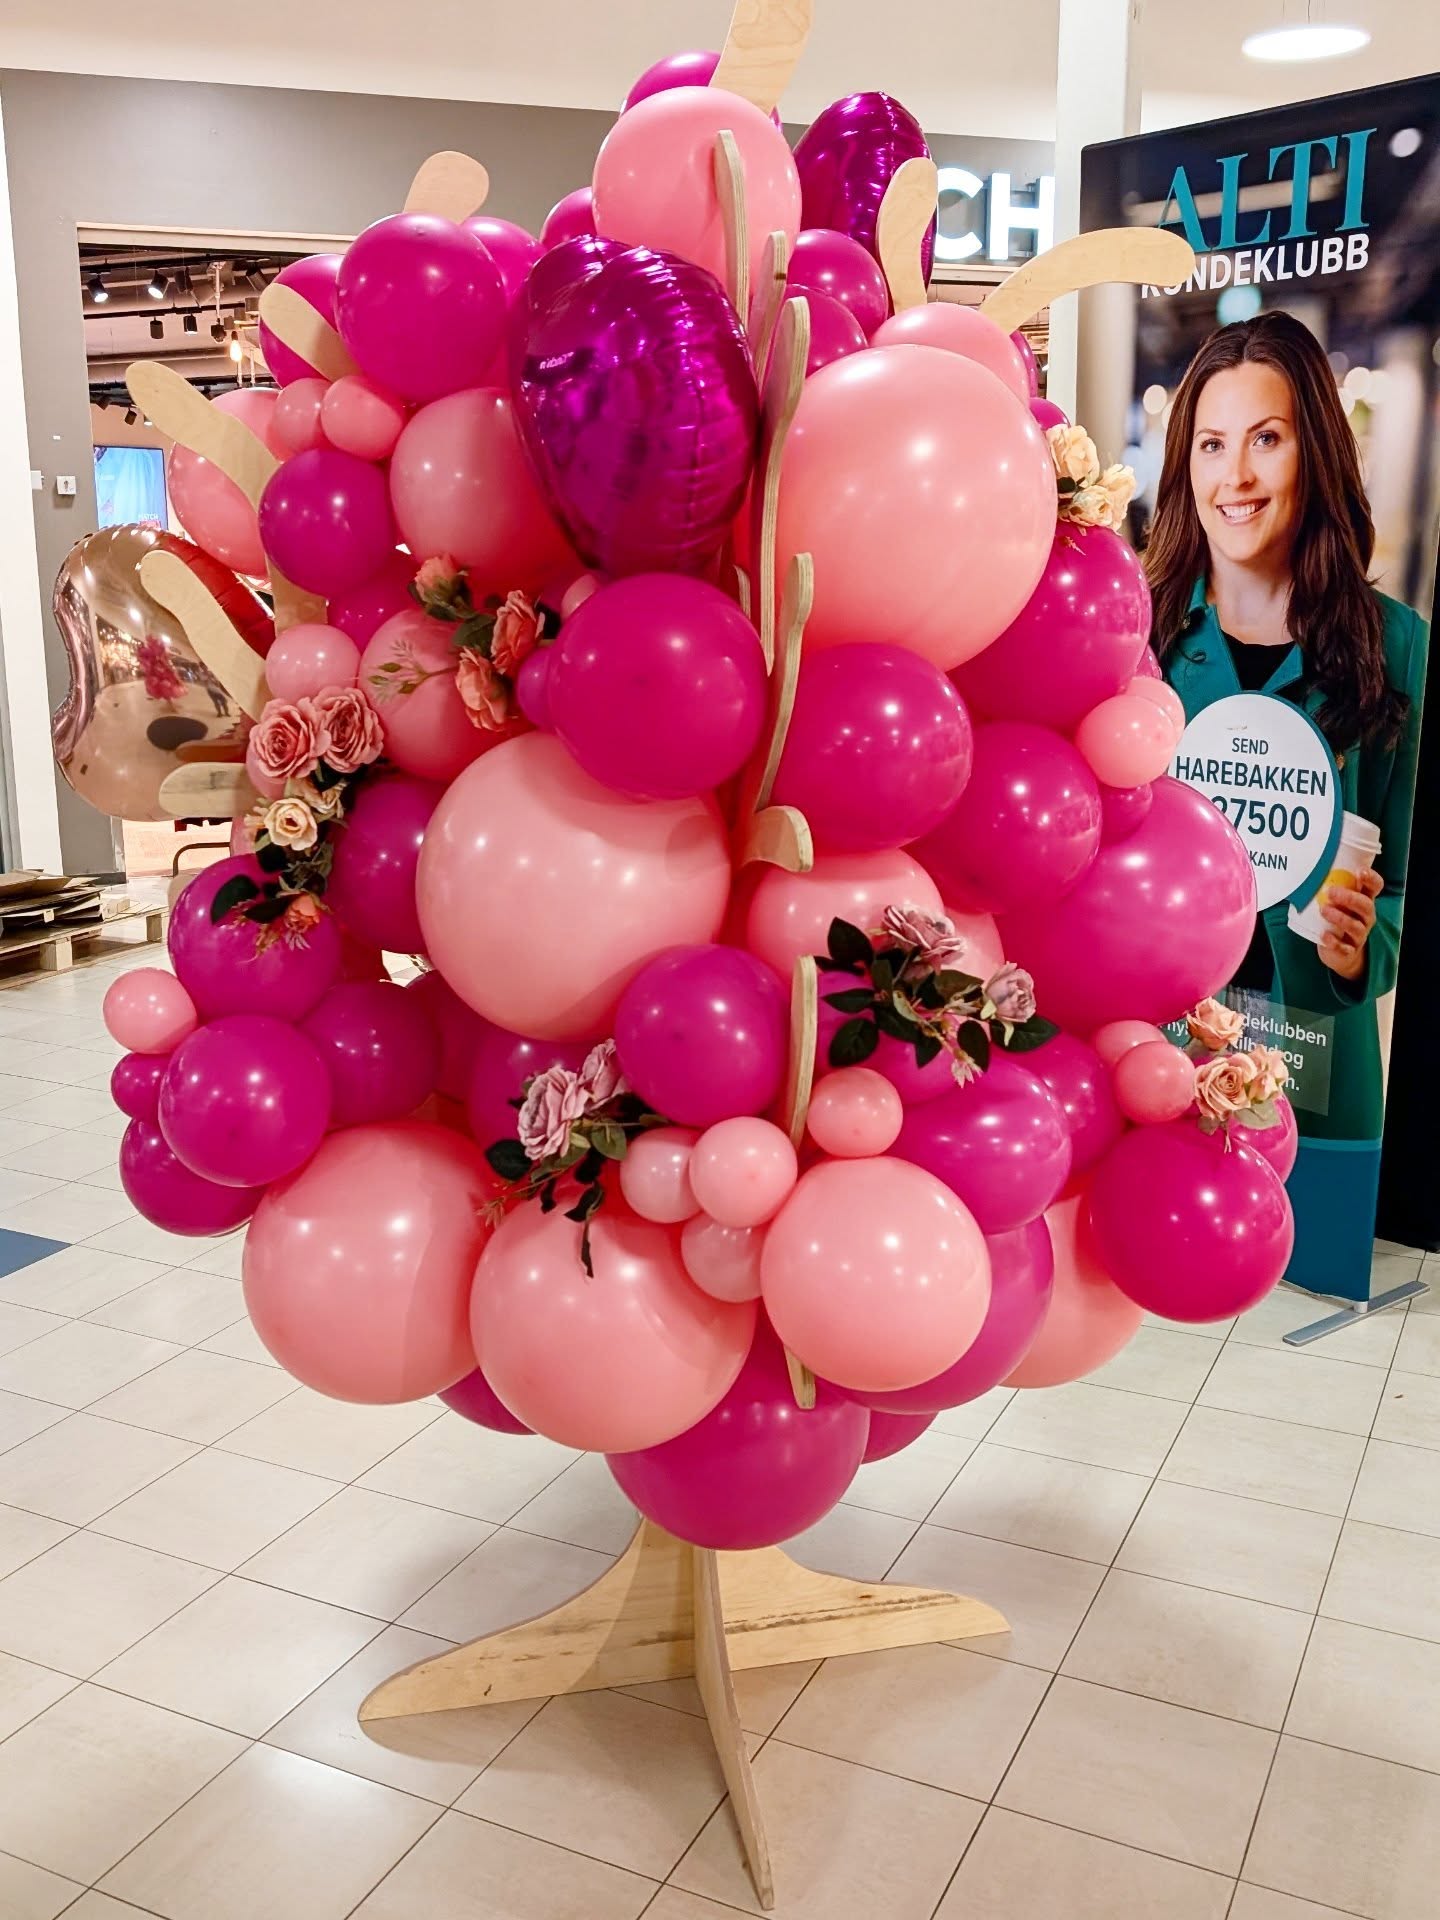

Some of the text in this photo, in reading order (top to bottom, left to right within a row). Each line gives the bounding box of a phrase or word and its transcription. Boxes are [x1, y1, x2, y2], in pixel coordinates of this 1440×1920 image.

[1157, 127, 1377, 254] ALTI
[1141, 232, 1369, 299] NDEKLUBB
[1231, 737, 1269, 755] SEND
[1175, 755, 1328, 797] HAREBAKKEN
[1241, 1012, 1327, 1047] deklubben
[1283, 1051, 1304, 1070] og
